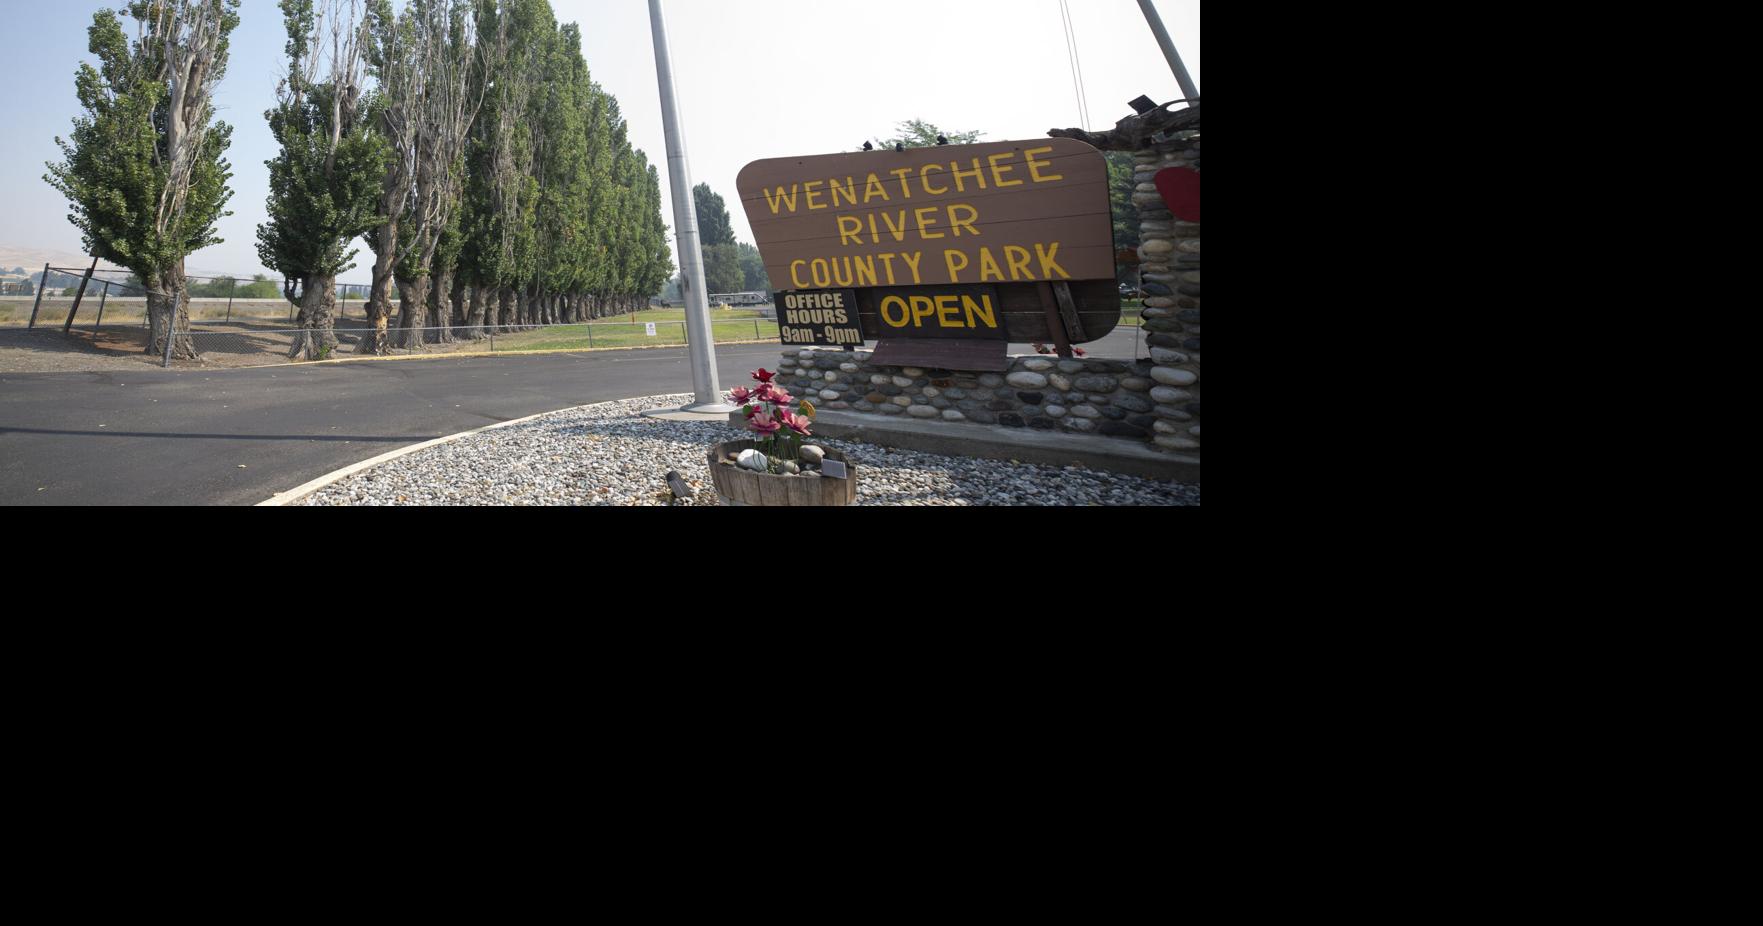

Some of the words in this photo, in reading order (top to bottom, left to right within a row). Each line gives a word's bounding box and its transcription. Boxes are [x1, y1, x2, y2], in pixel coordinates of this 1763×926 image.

[763, 146, 1062, 214] WENATCHEE
[836, 203, 981, 246] RIVER
[790, 251, 921, 288] COUNTY
[944, 241, 1071, 284] PARK
[785, 293, 844, 309] OFFICE
[787, 309, 848, 324] HOURS
[880, 294, 998, 329] OPEN
[782, 325, 814, 343] 9am
[825, 327, 860, 345] 9pm
